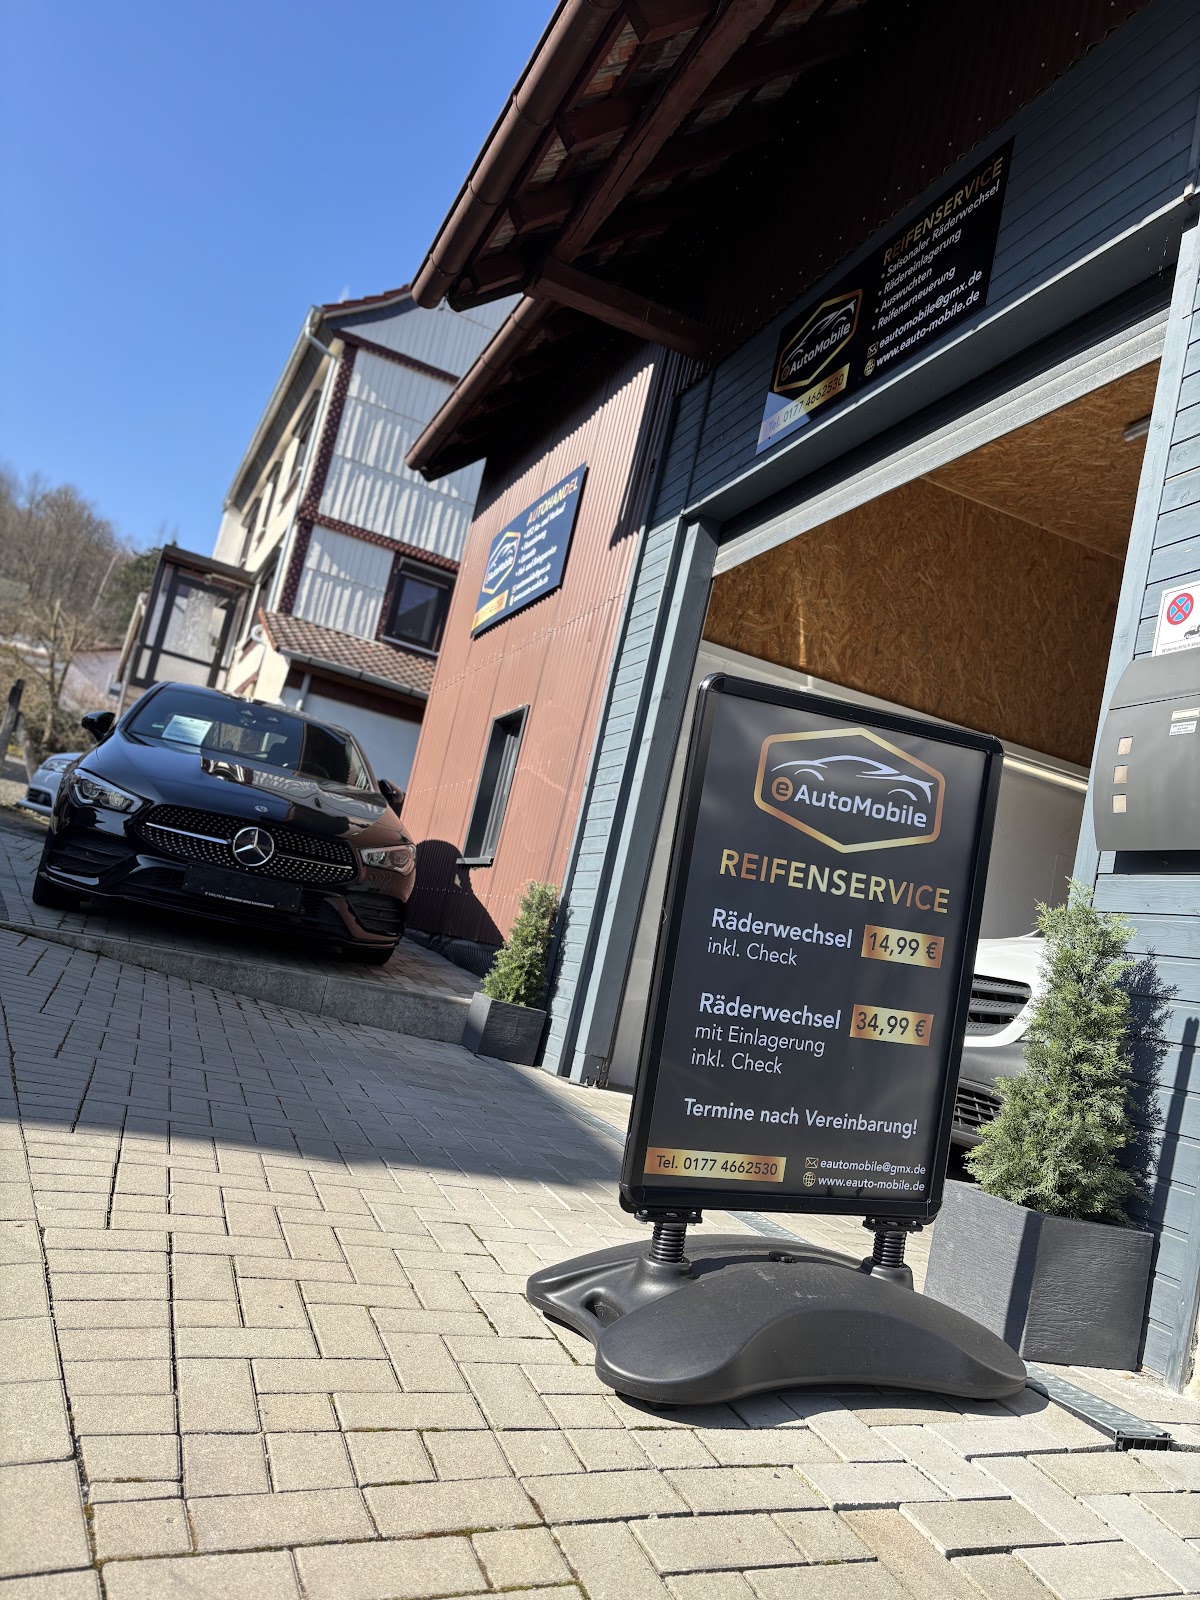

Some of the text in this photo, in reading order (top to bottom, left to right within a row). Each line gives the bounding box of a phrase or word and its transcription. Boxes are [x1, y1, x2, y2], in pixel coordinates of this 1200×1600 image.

[883, 157, 1003, 266] REIFENSERVICE
[887, 179, 999, 276] Saisonaler Räderwechsel
[883, 229, 961, 294] Rädereinlagerung
[877, 266, 956, 329] Reifenerneuerung
[879, 269, 982, 349] eautomobile@gmx.de
[880, 267, 932, 312] Auswuchten
[876, 290, 980, 367] www.eauto-mobile.de
[768, 373, 844, 431] Tel. 0177 4662530
[526, 476, 578, 527] AUTOHANDEL
[719, 849, 950, 913] REIFENSERVICE
[707, 937, 798, 966] inkl. Check
[711, 908, 938, 960] Räderwechsel 14,99 €
[699, 992, 927, 1037] Räderwechsel 34,99 €
[691, 1048, 783, 1074] inkl. Check
[694, 1025, 825, 1057] mit Einlagerung
[684, 1097, 918, 1139] Termine nach Vereinbarung!
[656, 1155, 778, 1176] Tel. 0177 4662530
[818, 1176, 925, 1191] www.eauto-mobile.de
[820, 1158, 926, 1175] eautomobile@gmx.de
